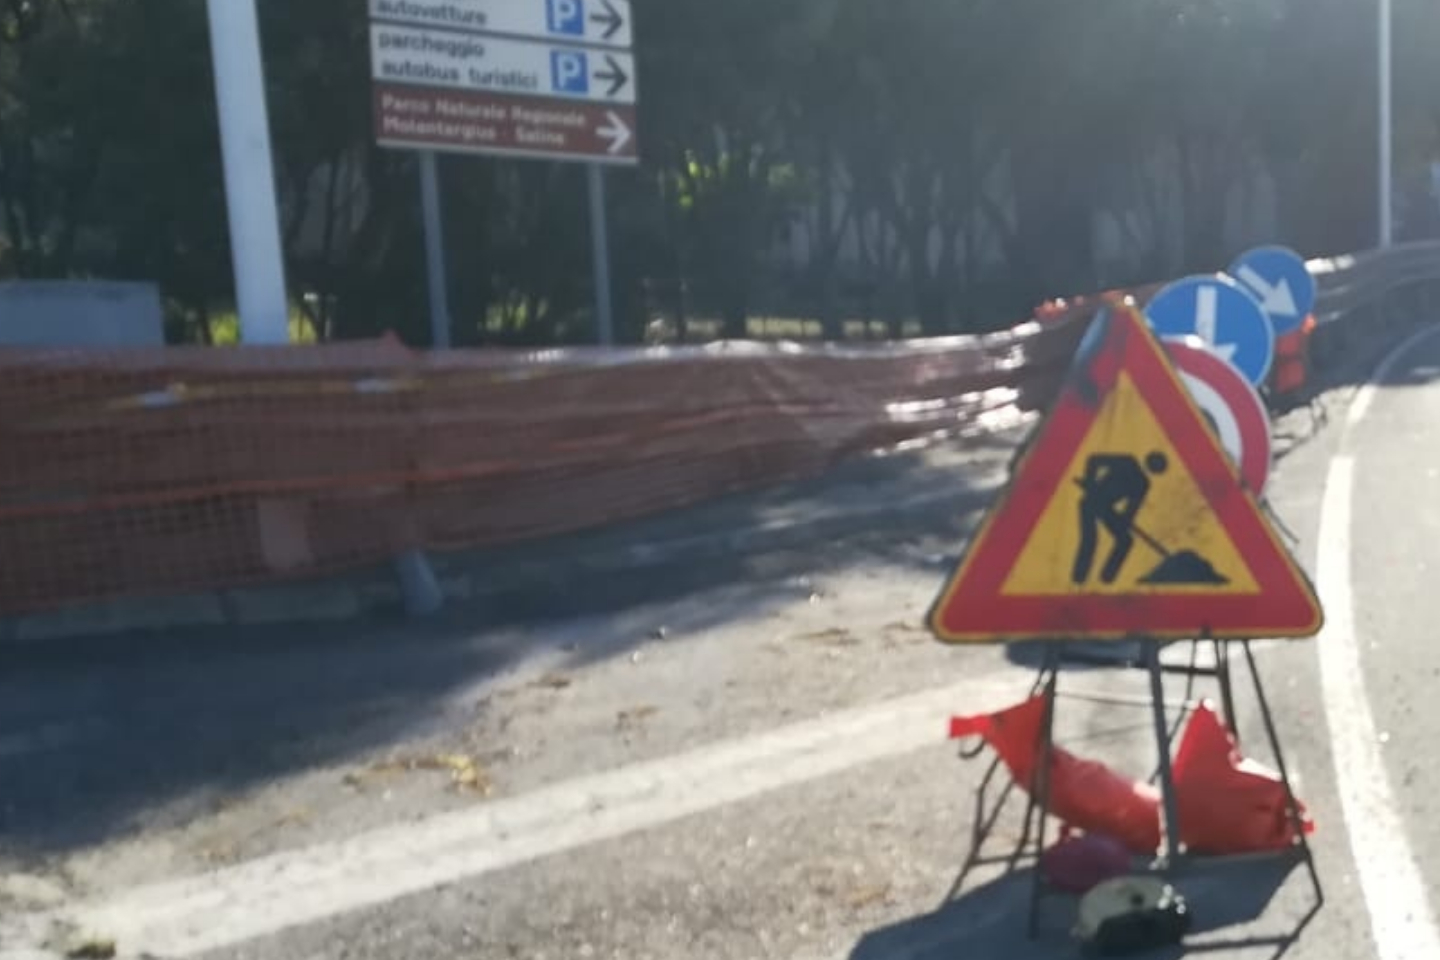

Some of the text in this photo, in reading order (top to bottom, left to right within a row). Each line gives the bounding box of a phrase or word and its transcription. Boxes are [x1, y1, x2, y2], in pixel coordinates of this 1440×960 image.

[378, 32, 486, 58] parcheggio
[381, 59, 459, 81] autobus
[468, 64, 539, 89] turistici
[381, 94, 586, 126] Parco Naturale Regionale
[382, 116, 497, 141] Molentargius
